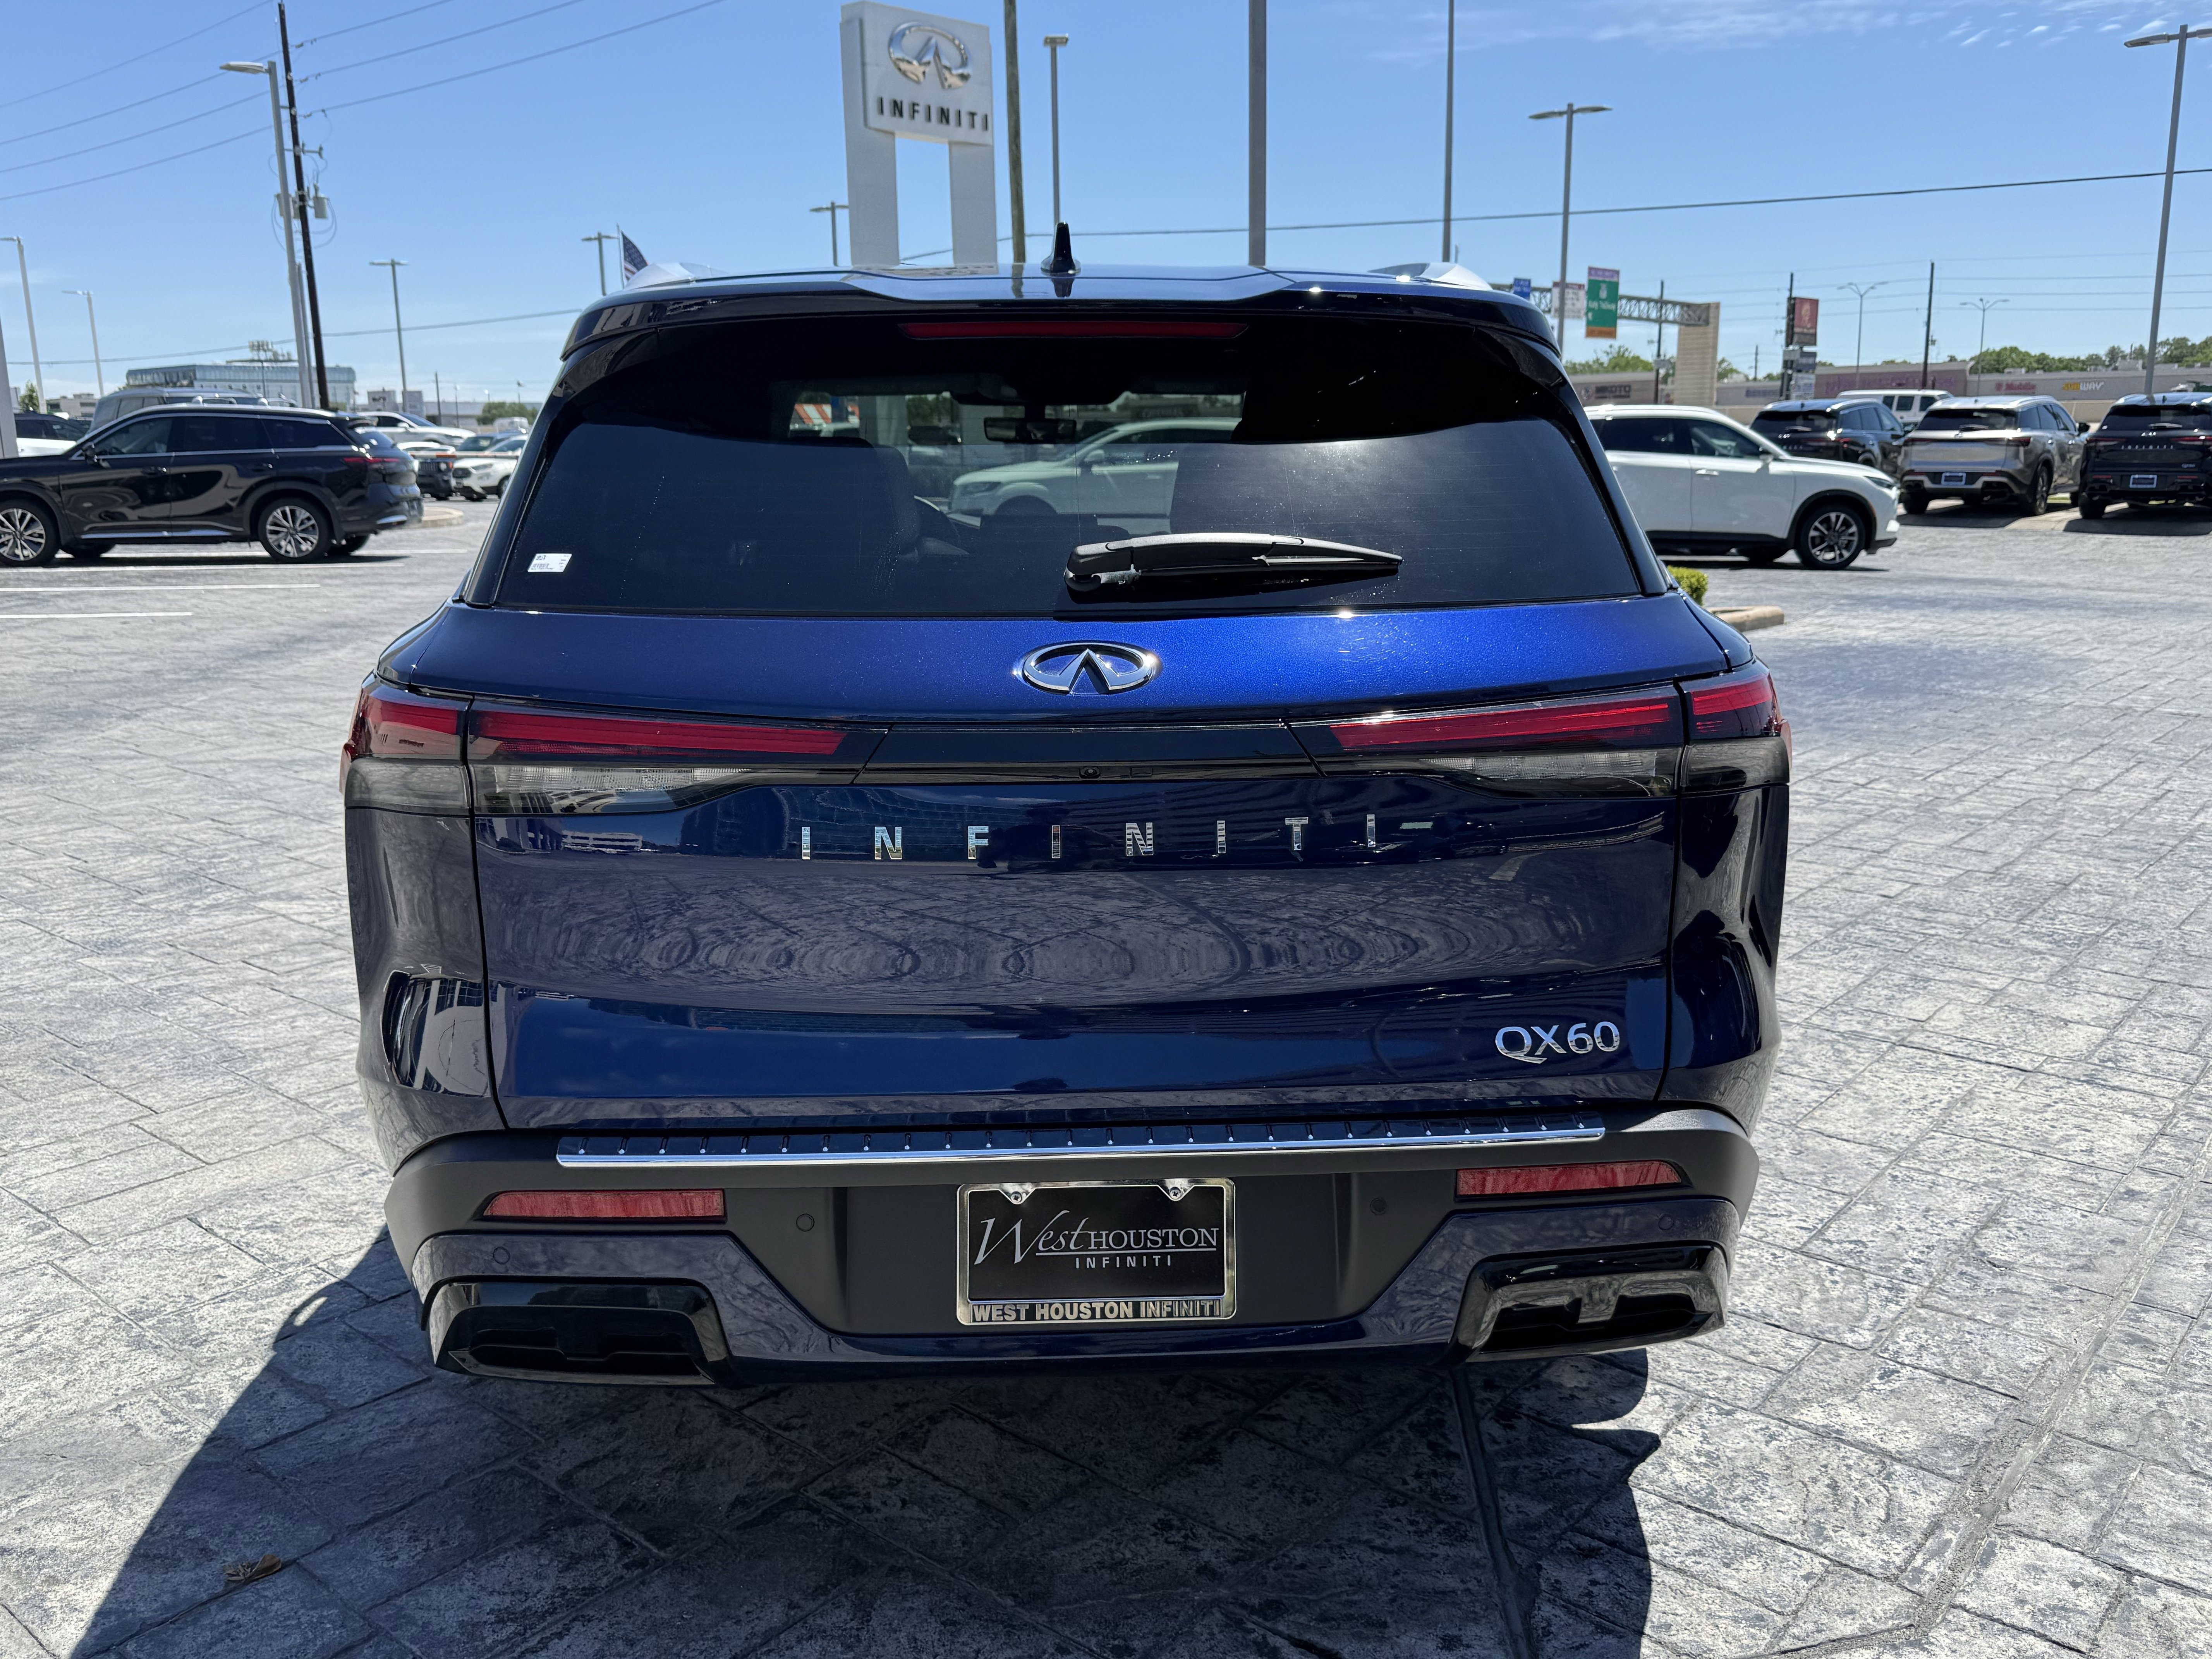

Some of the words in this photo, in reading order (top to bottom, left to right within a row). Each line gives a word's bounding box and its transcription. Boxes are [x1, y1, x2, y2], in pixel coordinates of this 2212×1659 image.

[878, 97, 988, 131] INFINITI
[802, 814, 1376, 860] INFINITI
[1495, 1021, 1620, 1064] QX60
[974, 1210, 1089, 1265] West
[1088, 1228, 1219, 1249] HOUSTON
[1076, 1255, 1171, 1269] INFINITI
[973, 1304, 1029, 1321] WEST
[1036, 1302, 1133, 1320] HOUSTON
[1140, 1300, 1219, 1317] INFINITI
